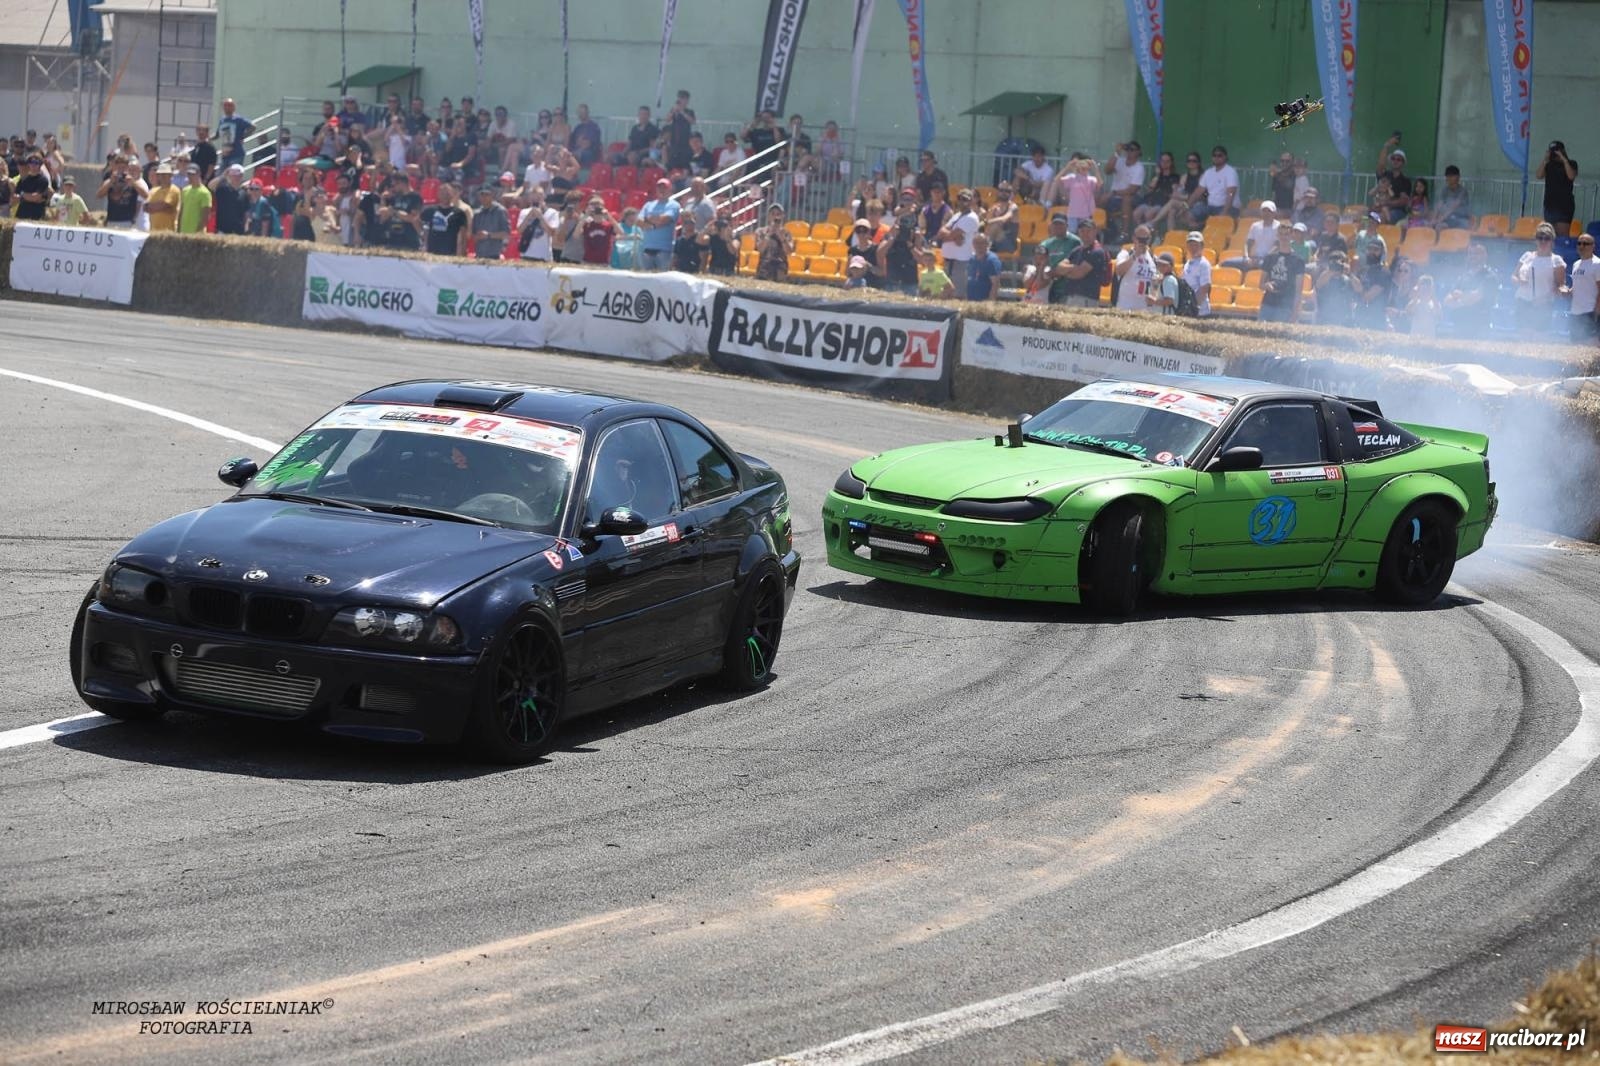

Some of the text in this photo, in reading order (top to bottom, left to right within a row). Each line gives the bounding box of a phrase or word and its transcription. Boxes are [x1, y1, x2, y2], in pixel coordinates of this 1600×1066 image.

[34, 228, 114, 247] AUTO FUS
[42, 258, 97, 276] GROUP
[331, 281, 413, 312] AGROEKO
[458, 291, 541, 321] AGROEKO
[728, 307, 908, 367] RALLYSHOP
[1357, 434, 1401, 446] TECŁAW
[1325, 467, 1339, 479] 031
[1251, 502, 1296, 541] 31
